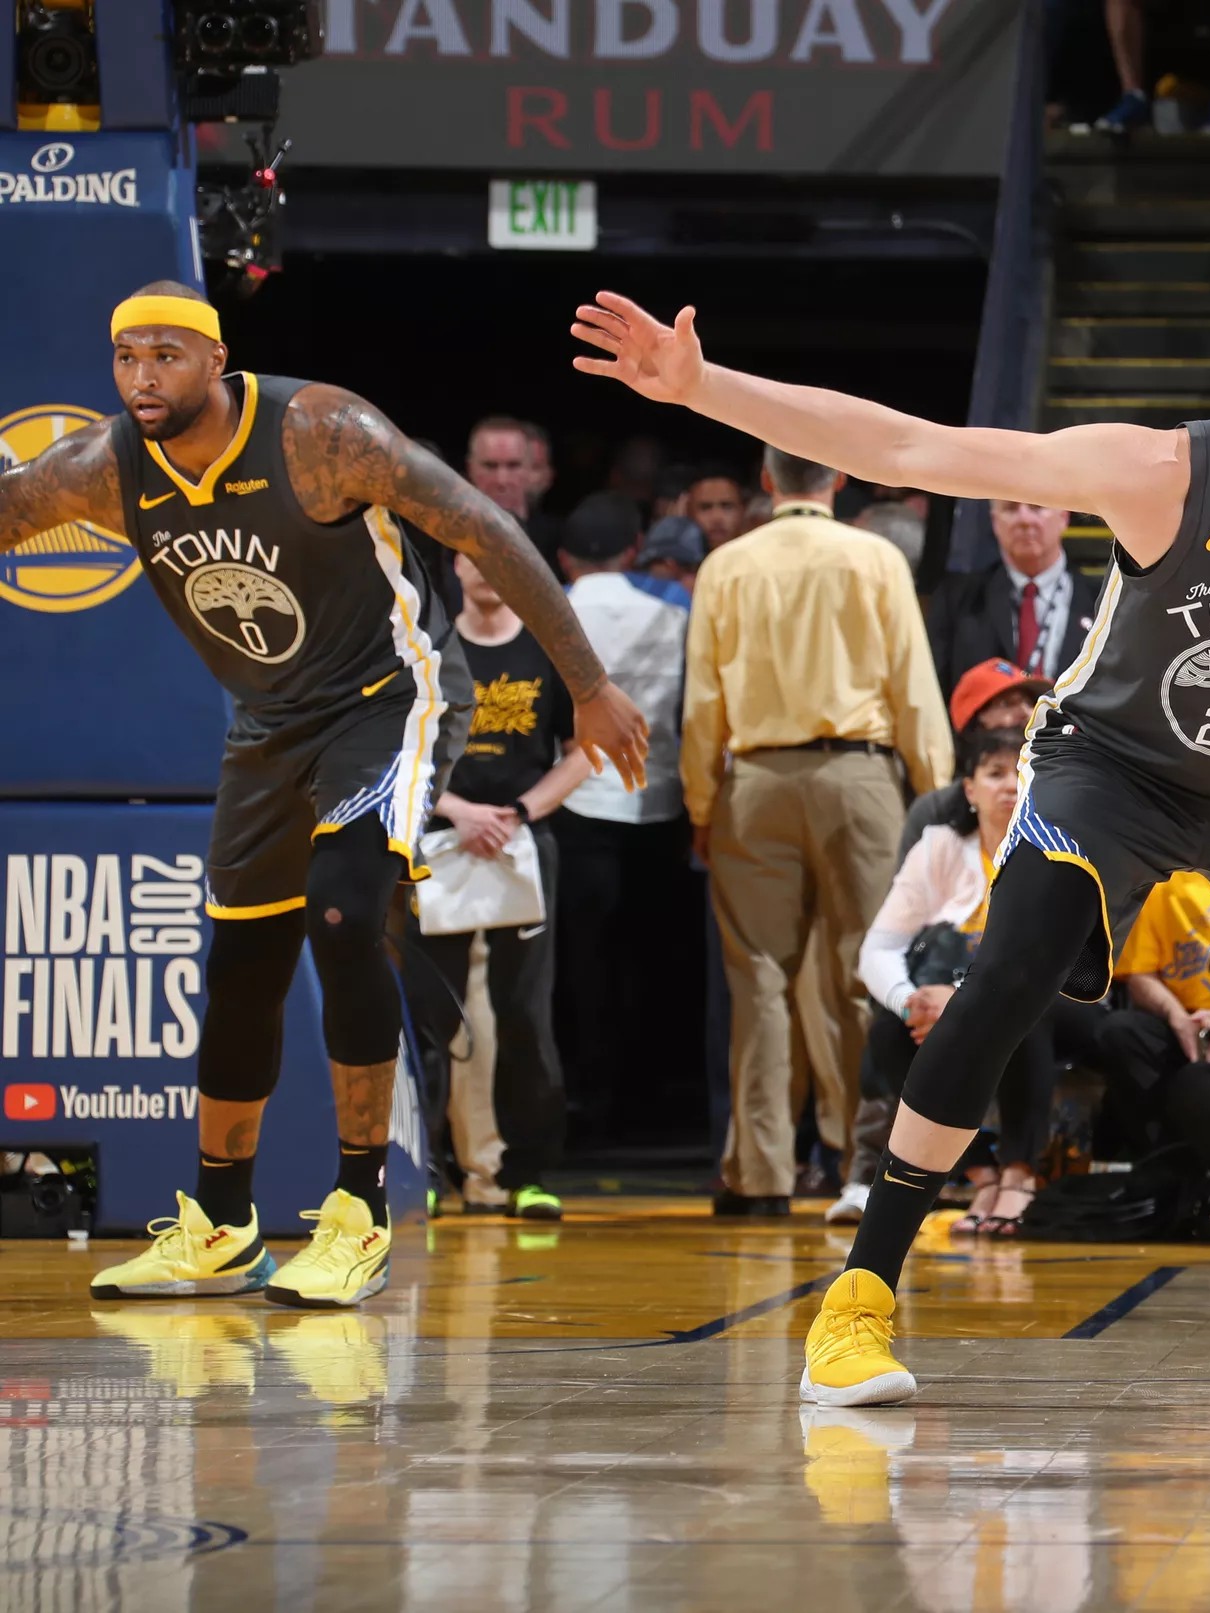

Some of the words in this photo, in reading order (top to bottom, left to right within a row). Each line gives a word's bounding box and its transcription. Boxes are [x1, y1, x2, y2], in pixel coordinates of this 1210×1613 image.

[505, 86, 775, 151] RUM
[0, 168, 138, 207] PALDING
[509, 179, 579, 236] EXIT
[224, 478, 269, 495] Rakuten
[151, 528, 280, 576] TOWN
[239, 621, 269, 655] 0
[5, 854, 127, 955] NBA
[129, 854, 204, 955] 2019
[2, 957, 201, 1058] FINALS
